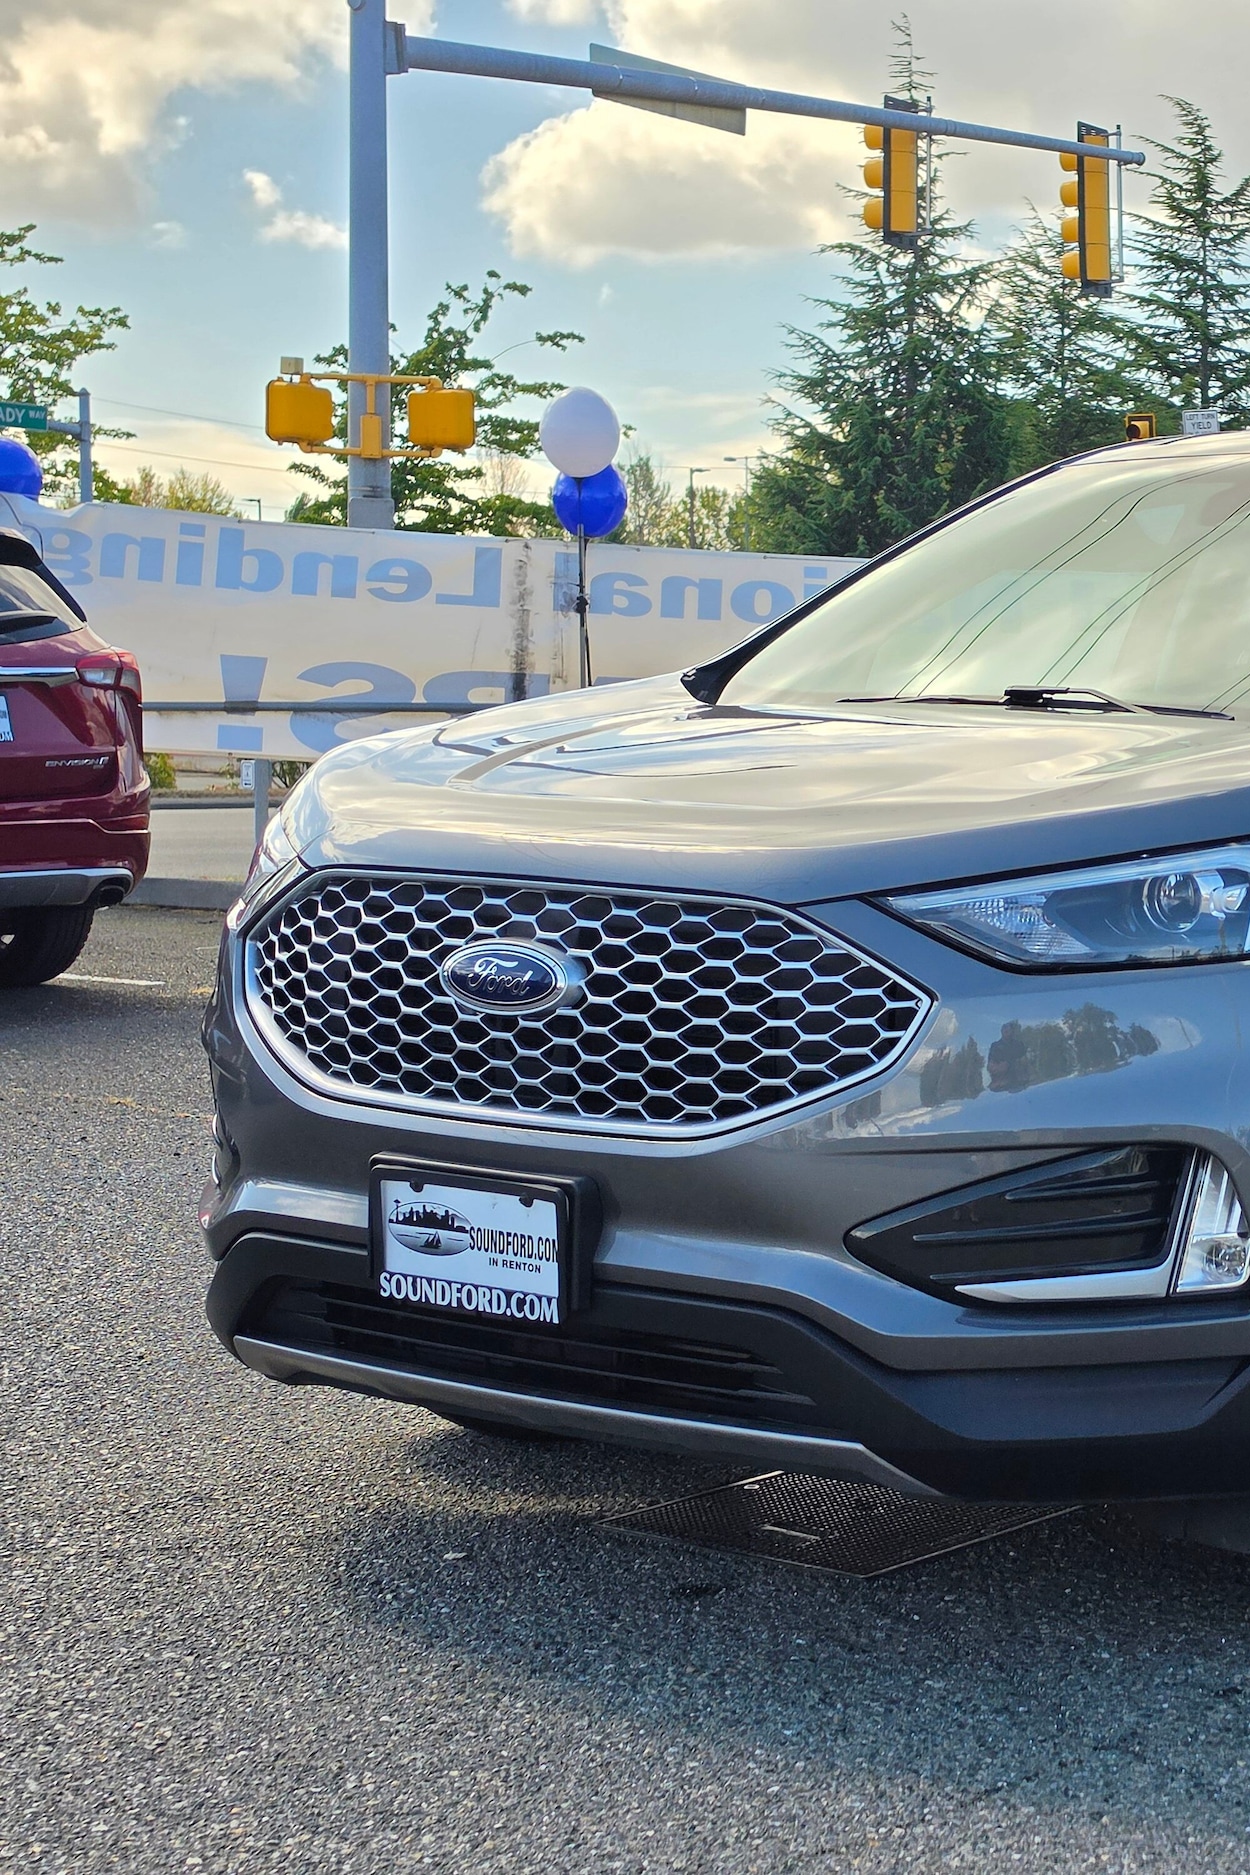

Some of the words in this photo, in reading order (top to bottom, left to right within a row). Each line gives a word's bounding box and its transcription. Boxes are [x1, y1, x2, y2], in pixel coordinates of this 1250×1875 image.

[29, 410, 46, 419] WAY
[1186, 413, 1199, 421] LEFT
[1191, 421, 1212, 430] YIELD
[45, 758, 99, 767] ENVISION
[467, 956, 534, 997] Ford
[488, 1257, 498, 1267] IN
[502, 1259, 541, 1274] RENTON
[379, 1271, 560, 1324] SOUNDFORD.COM
